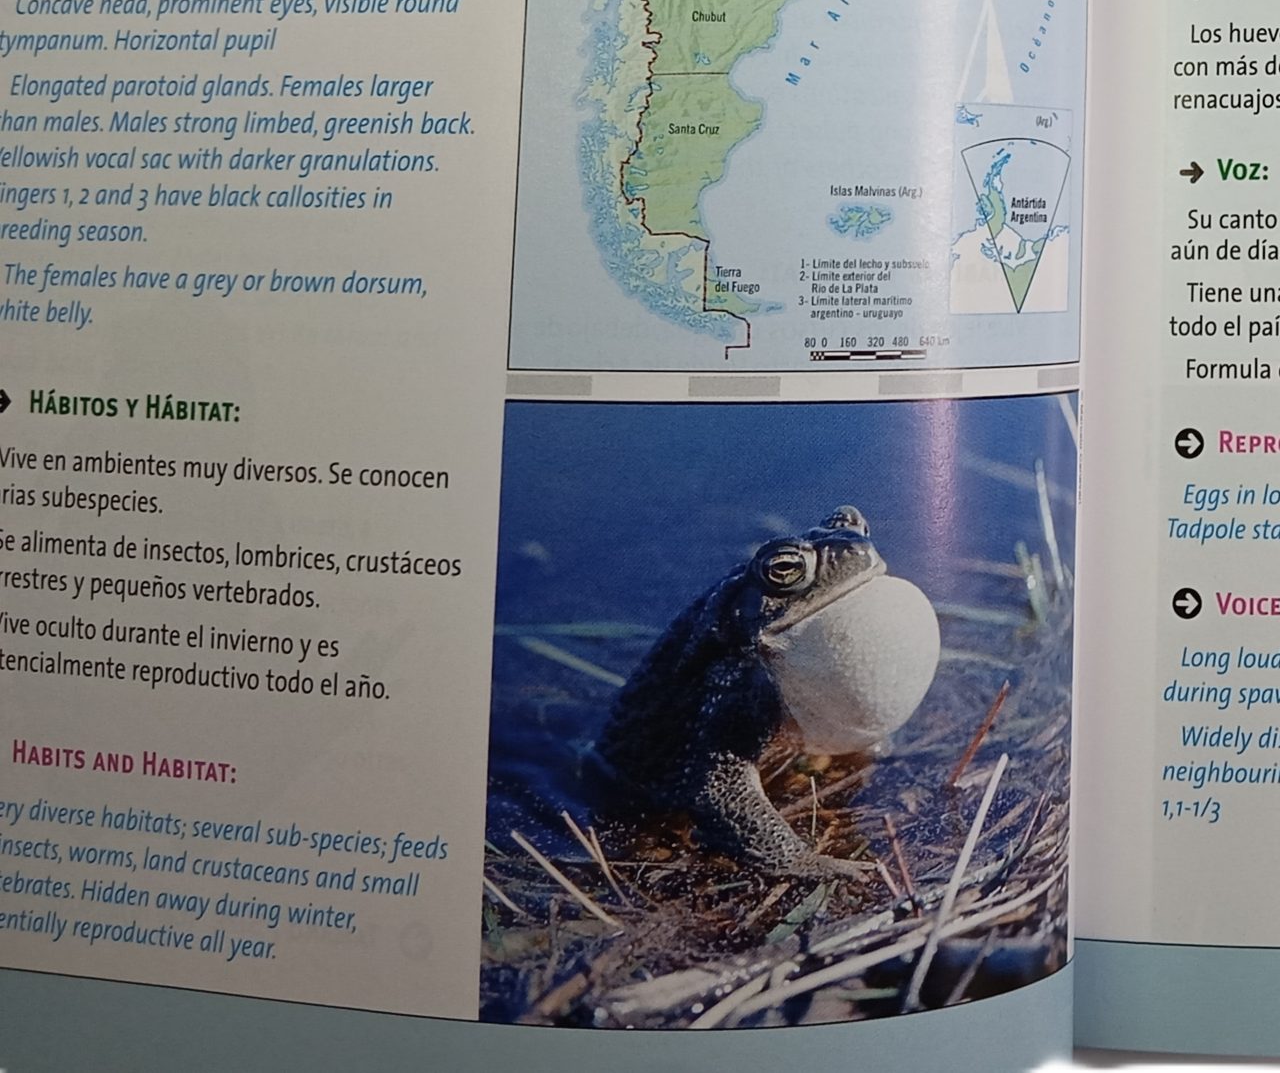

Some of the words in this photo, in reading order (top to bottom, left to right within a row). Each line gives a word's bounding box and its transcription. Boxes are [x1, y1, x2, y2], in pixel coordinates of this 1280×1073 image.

[691, 11, 726, 24] Chubut
[1191, 24, 1222, 44] Los
[786, 40, 819, 86] Mar
[668, 124, 693, 135] Santa
[696, 124, 720, 136] Cruz
[830, 186, 852, 197] Islas
[855, 186, 897, 198] Malvinas
[1011, 197, 1046, 209] Antártida
[1011, 212, 1047, 224] Argentina
[715, 267, 741, 278] Tierra
[843, 272, 874, 281] exterior
[877, 272, 890, 281] del
[715, 282, 729, 293] del
[732, 282, 760, 295] Fuego
[829, 284, 839, 293] de
[842, 284, 852, 294] La
[855, 284, 878, 293] Plata
[842, 296, 870, 306] lateral
[804, 338, 816, 348] 80
[840, 337, 856, 347] 160
[867, 337, 884, 347] 320
[892, 337, 908, 347] 480
[29, 388, 119, 418] HÁBITOS
[145, 393, 240, 423] HÁBITAT:
[12, 738, 86, 770] HABITS
[92, 751, 134, 774] AND
[142, 750, 237, 784] HABITAT:
